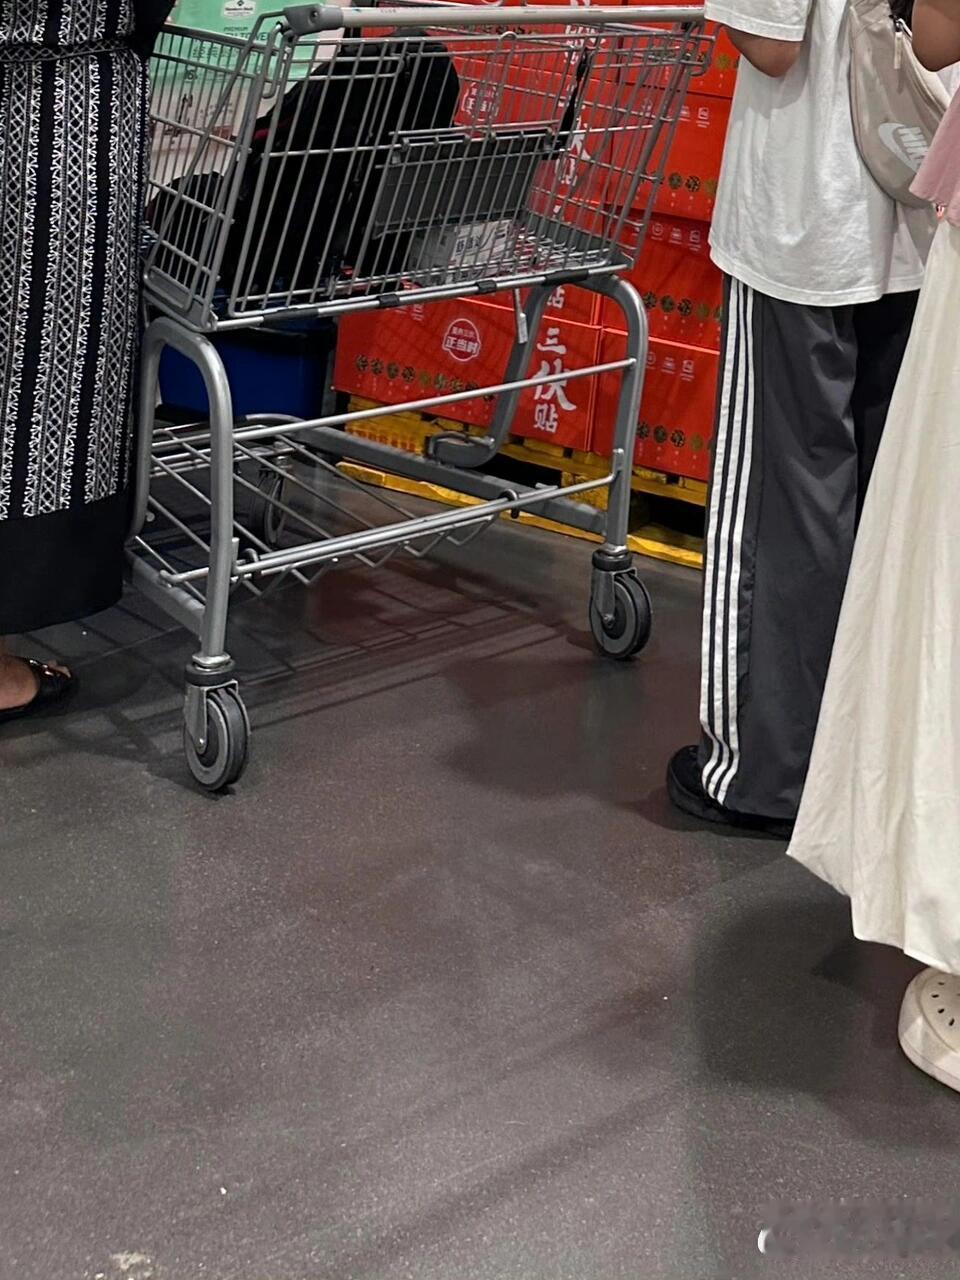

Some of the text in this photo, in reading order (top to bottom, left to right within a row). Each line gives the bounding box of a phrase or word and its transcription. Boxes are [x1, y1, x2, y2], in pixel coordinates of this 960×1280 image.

[445, 336, 479, 353] 正当时
[533, 328, 577, 433] 三伏贴
